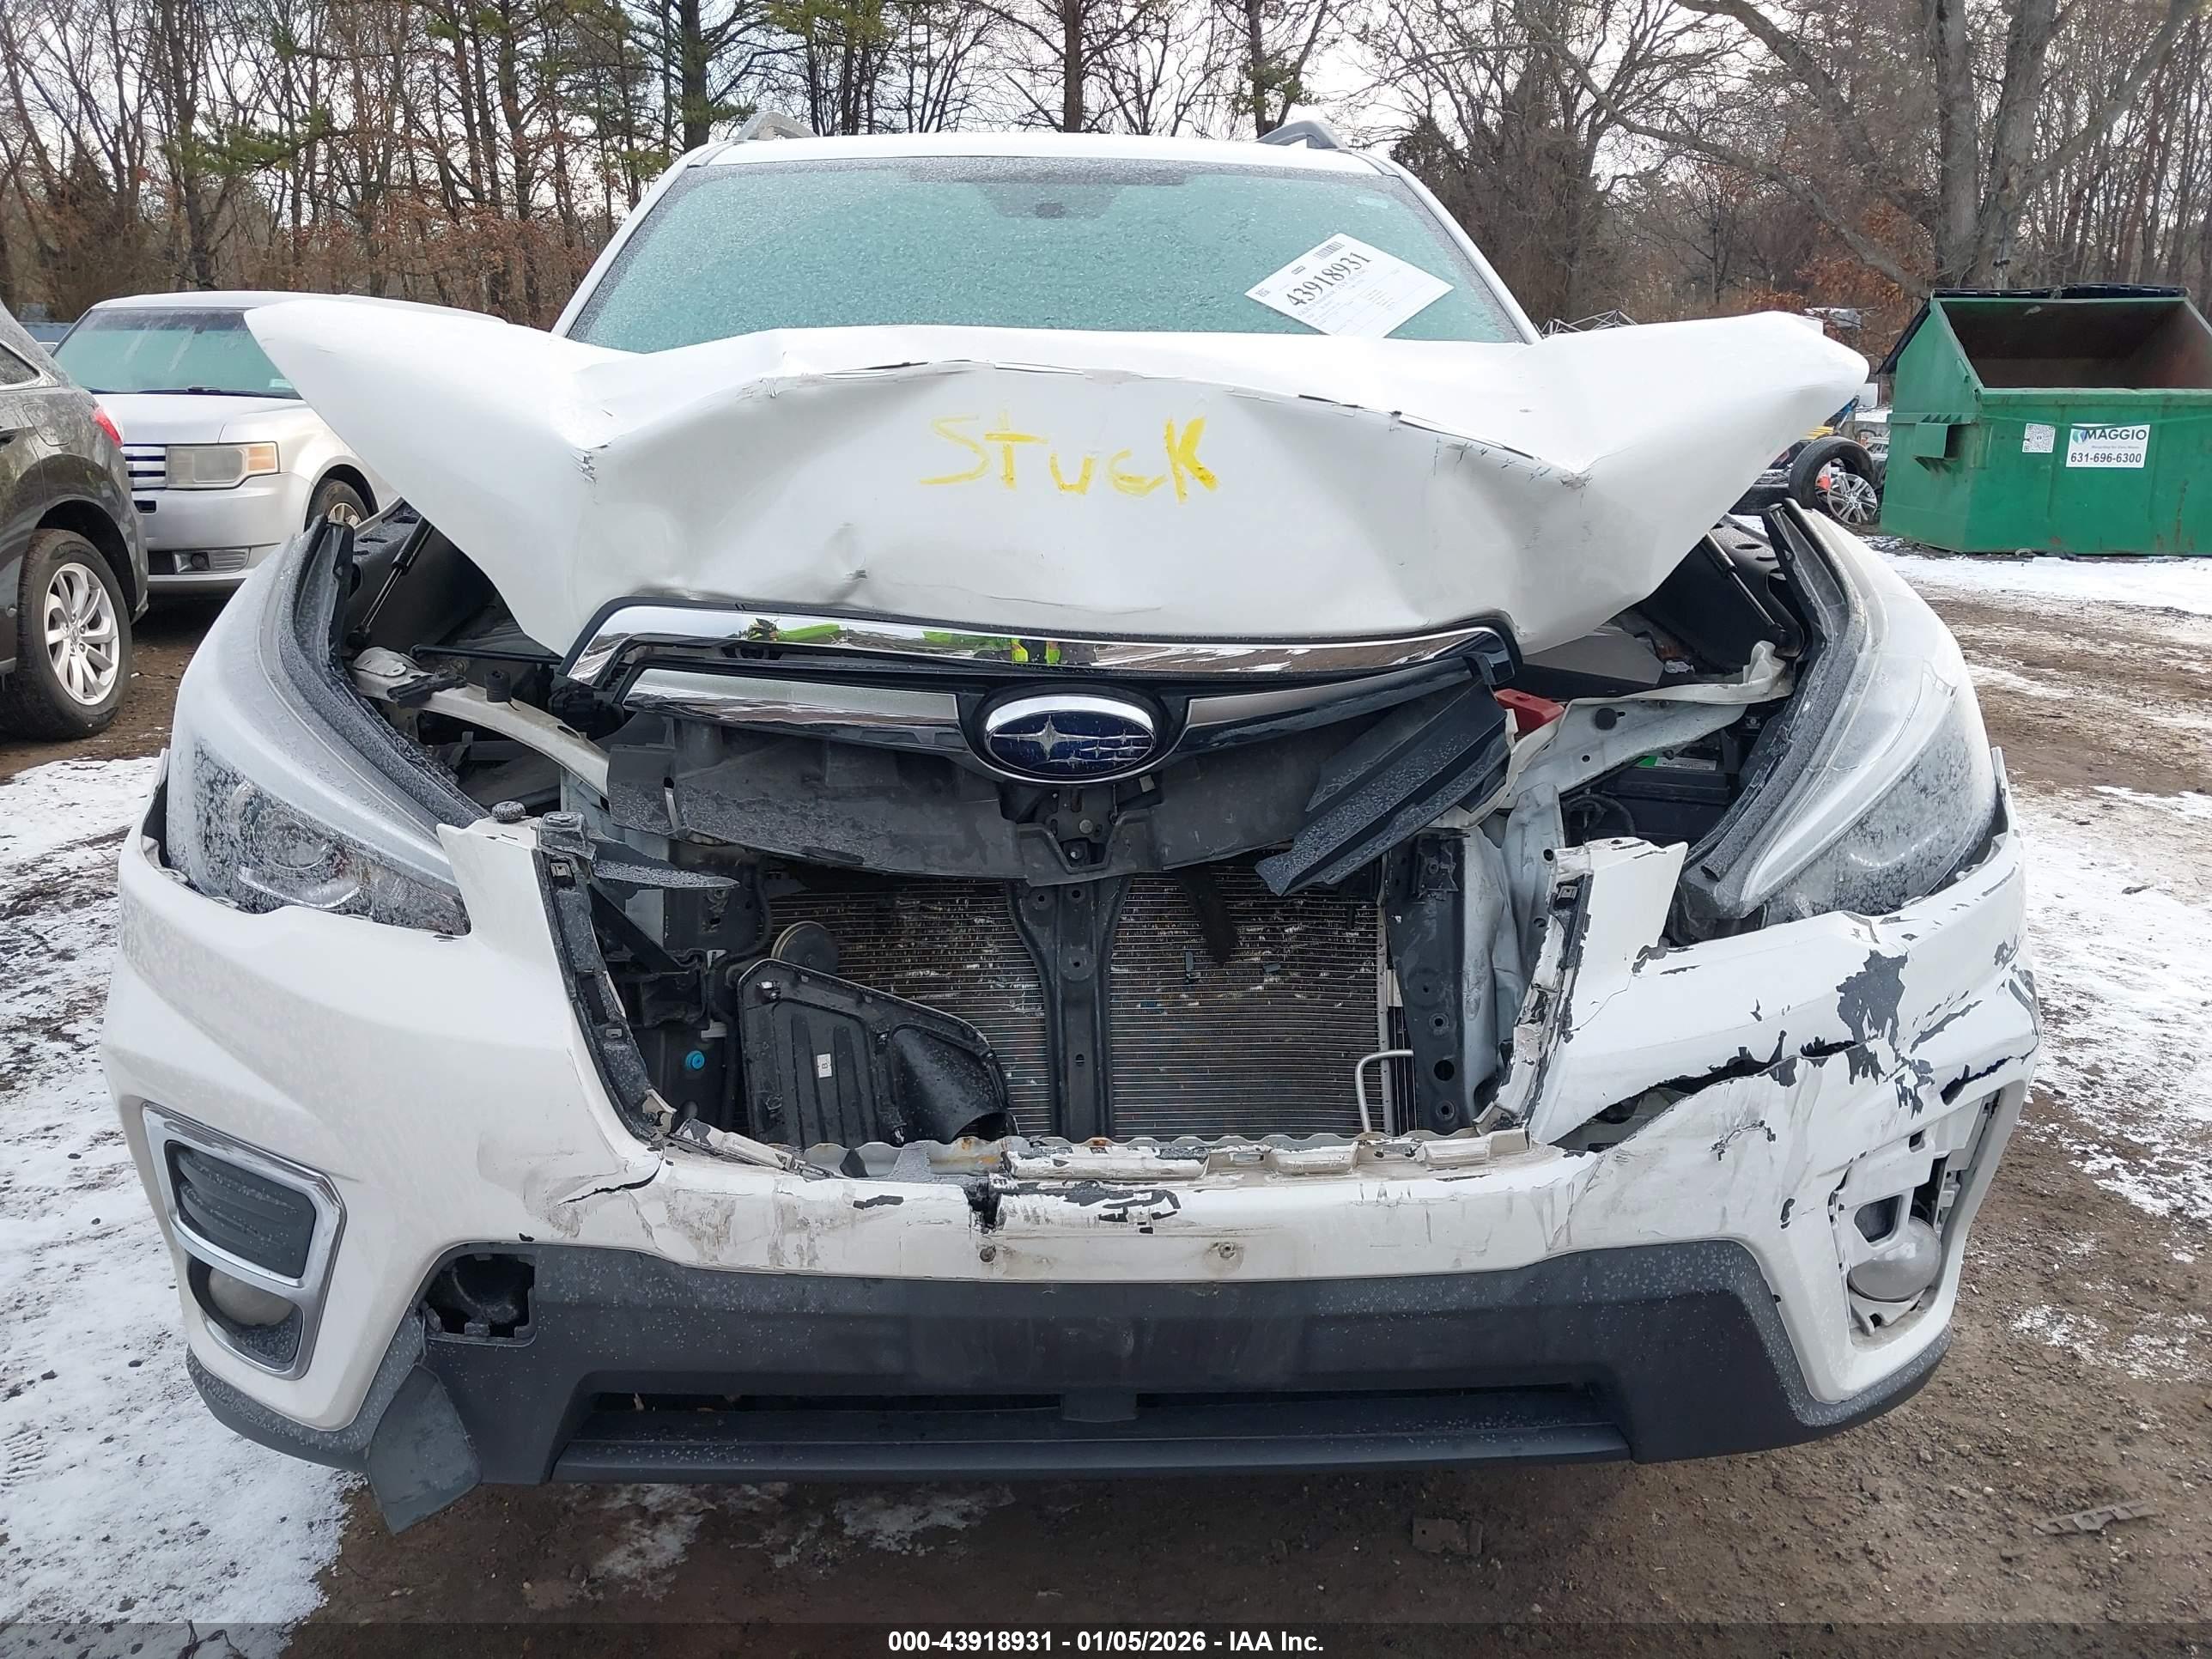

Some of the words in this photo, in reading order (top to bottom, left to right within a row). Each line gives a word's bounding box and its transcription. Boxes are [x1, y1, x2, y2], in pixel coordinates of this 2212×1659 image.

[1285, 252, 1372, 307] 43918931
[2085, 428, 2147, 441] MAGGIO
[2070, 452, 2142, 464] 631-696-6300
